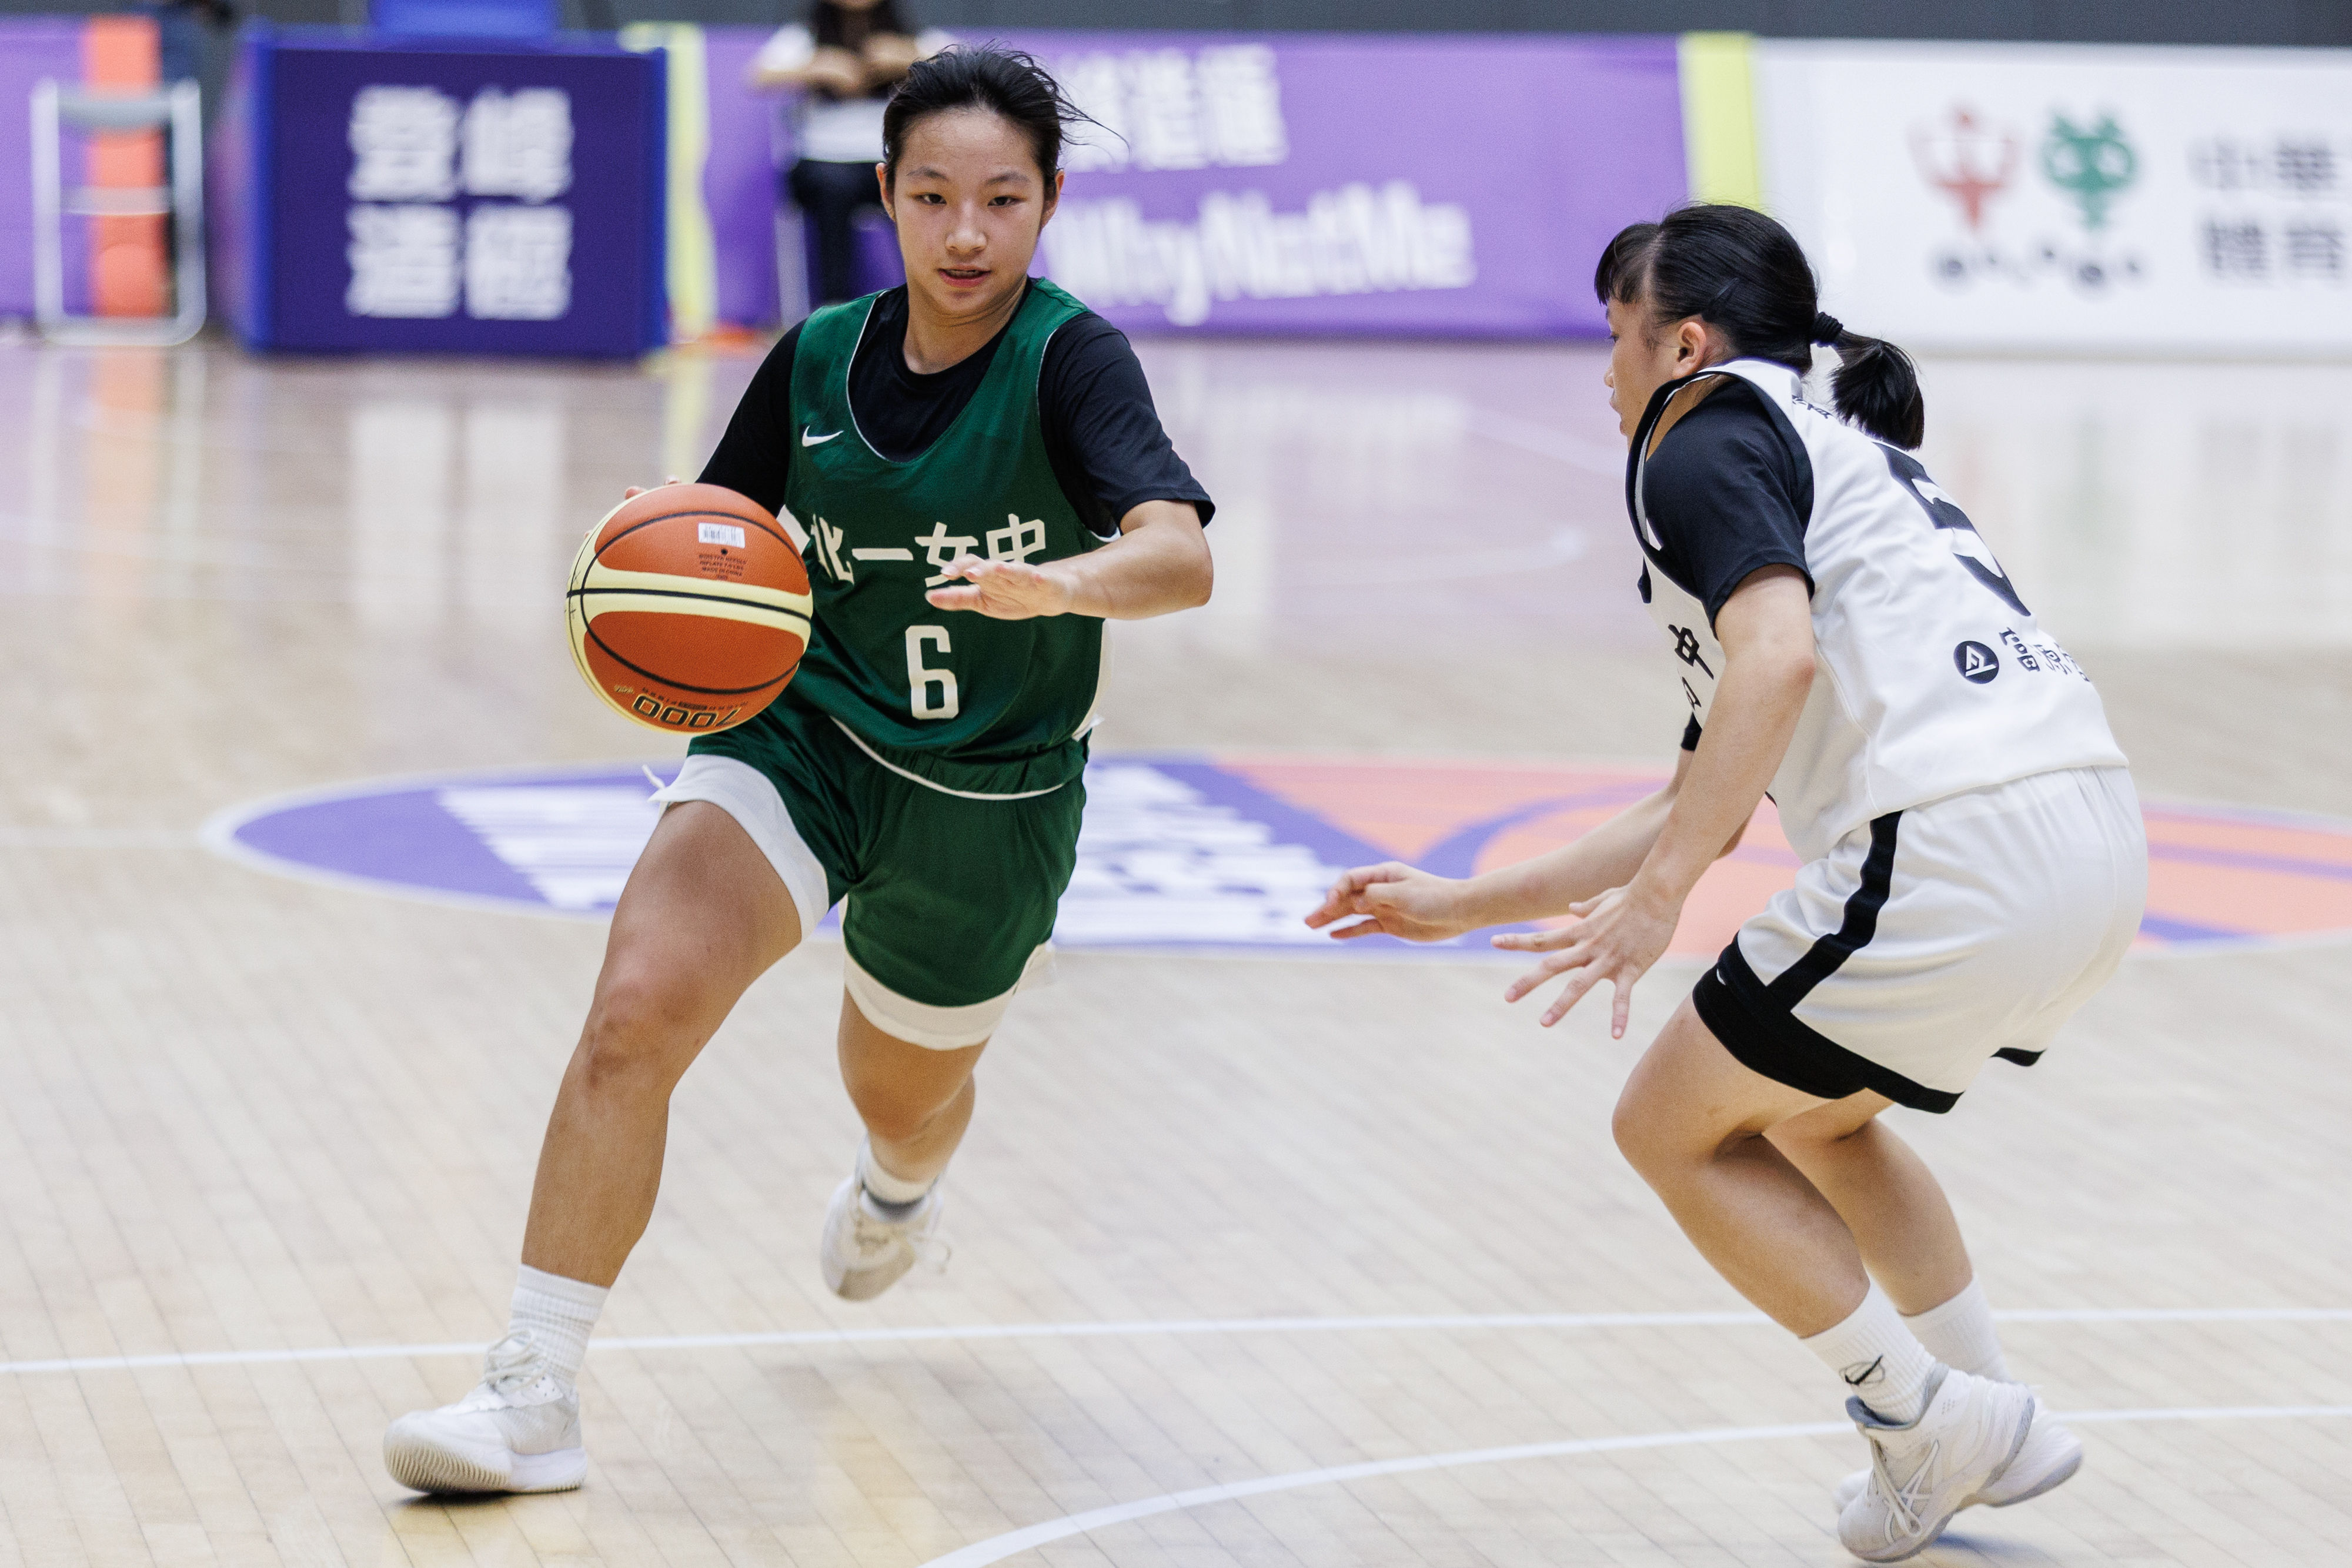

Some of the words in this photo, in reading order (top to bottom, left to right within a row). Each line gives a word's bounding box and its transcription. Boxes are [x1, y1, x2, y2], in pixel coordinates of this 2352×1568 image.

[810, 513, 1047, 588] 北一女中
[905, 625, 959, 720] 6
[1668, 624, 1715, 680] 中
[632, 693, 742, 729] 7000
